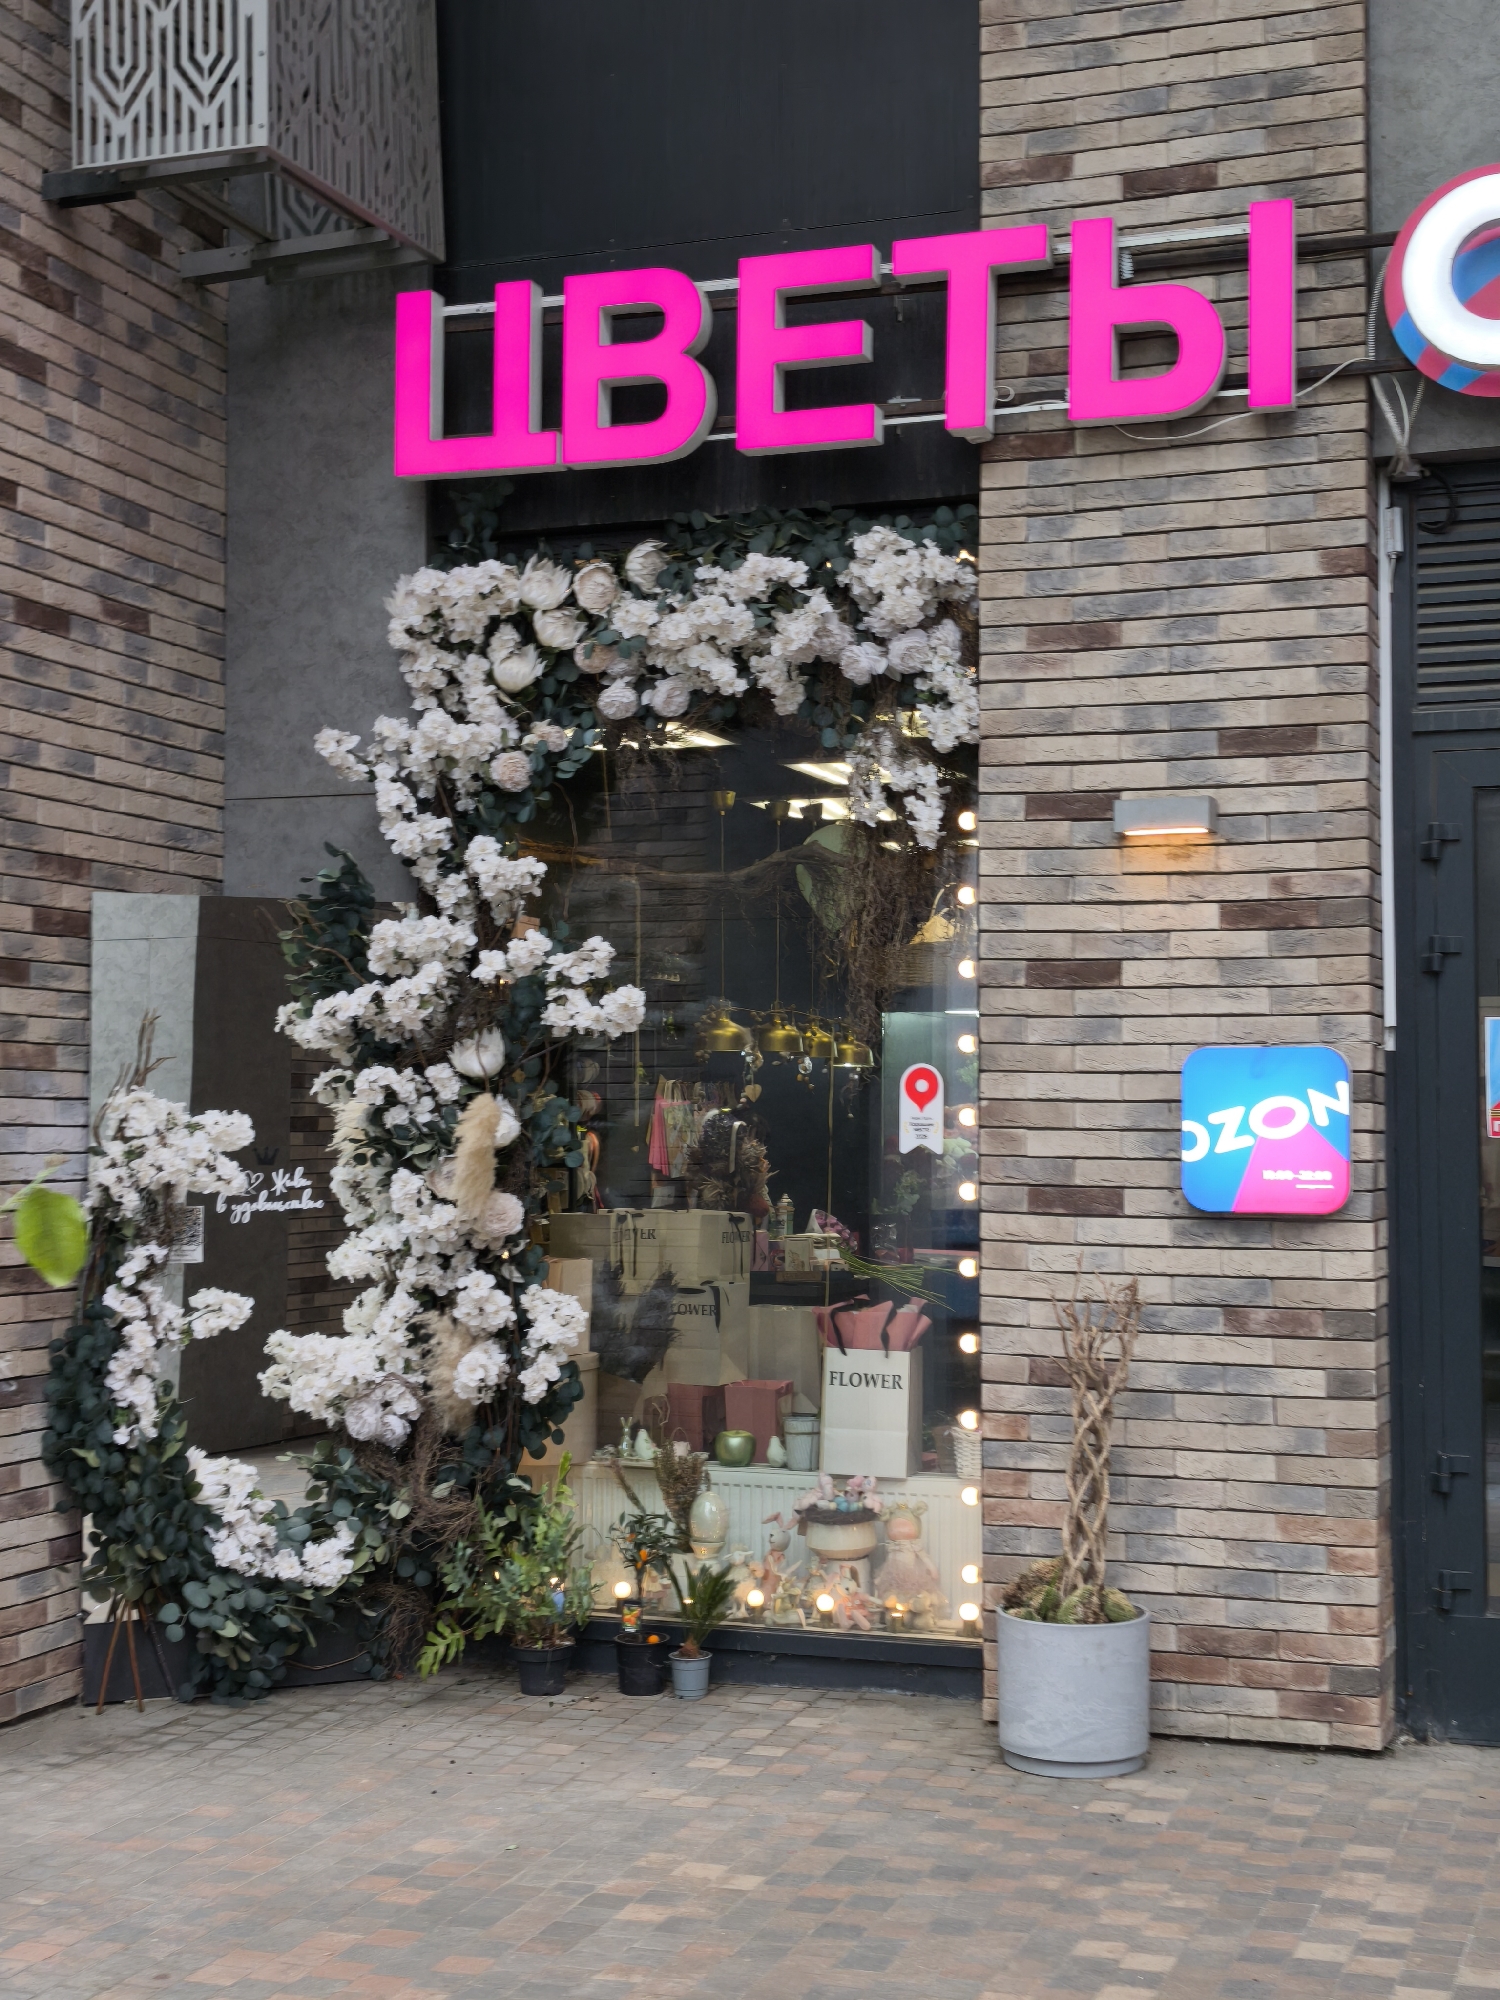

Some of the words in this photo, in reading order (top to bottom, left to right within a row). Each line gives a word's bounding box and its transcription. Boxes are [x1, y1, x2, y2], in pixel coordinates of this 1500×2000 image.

[394, 199, 1298, 479] ЦВЕТЫ
[721, 1231, 751, 1244] FLOER
[674, 1303, 716, 1317] OWER
[829, 1370, 904, 1390] FLOWER
